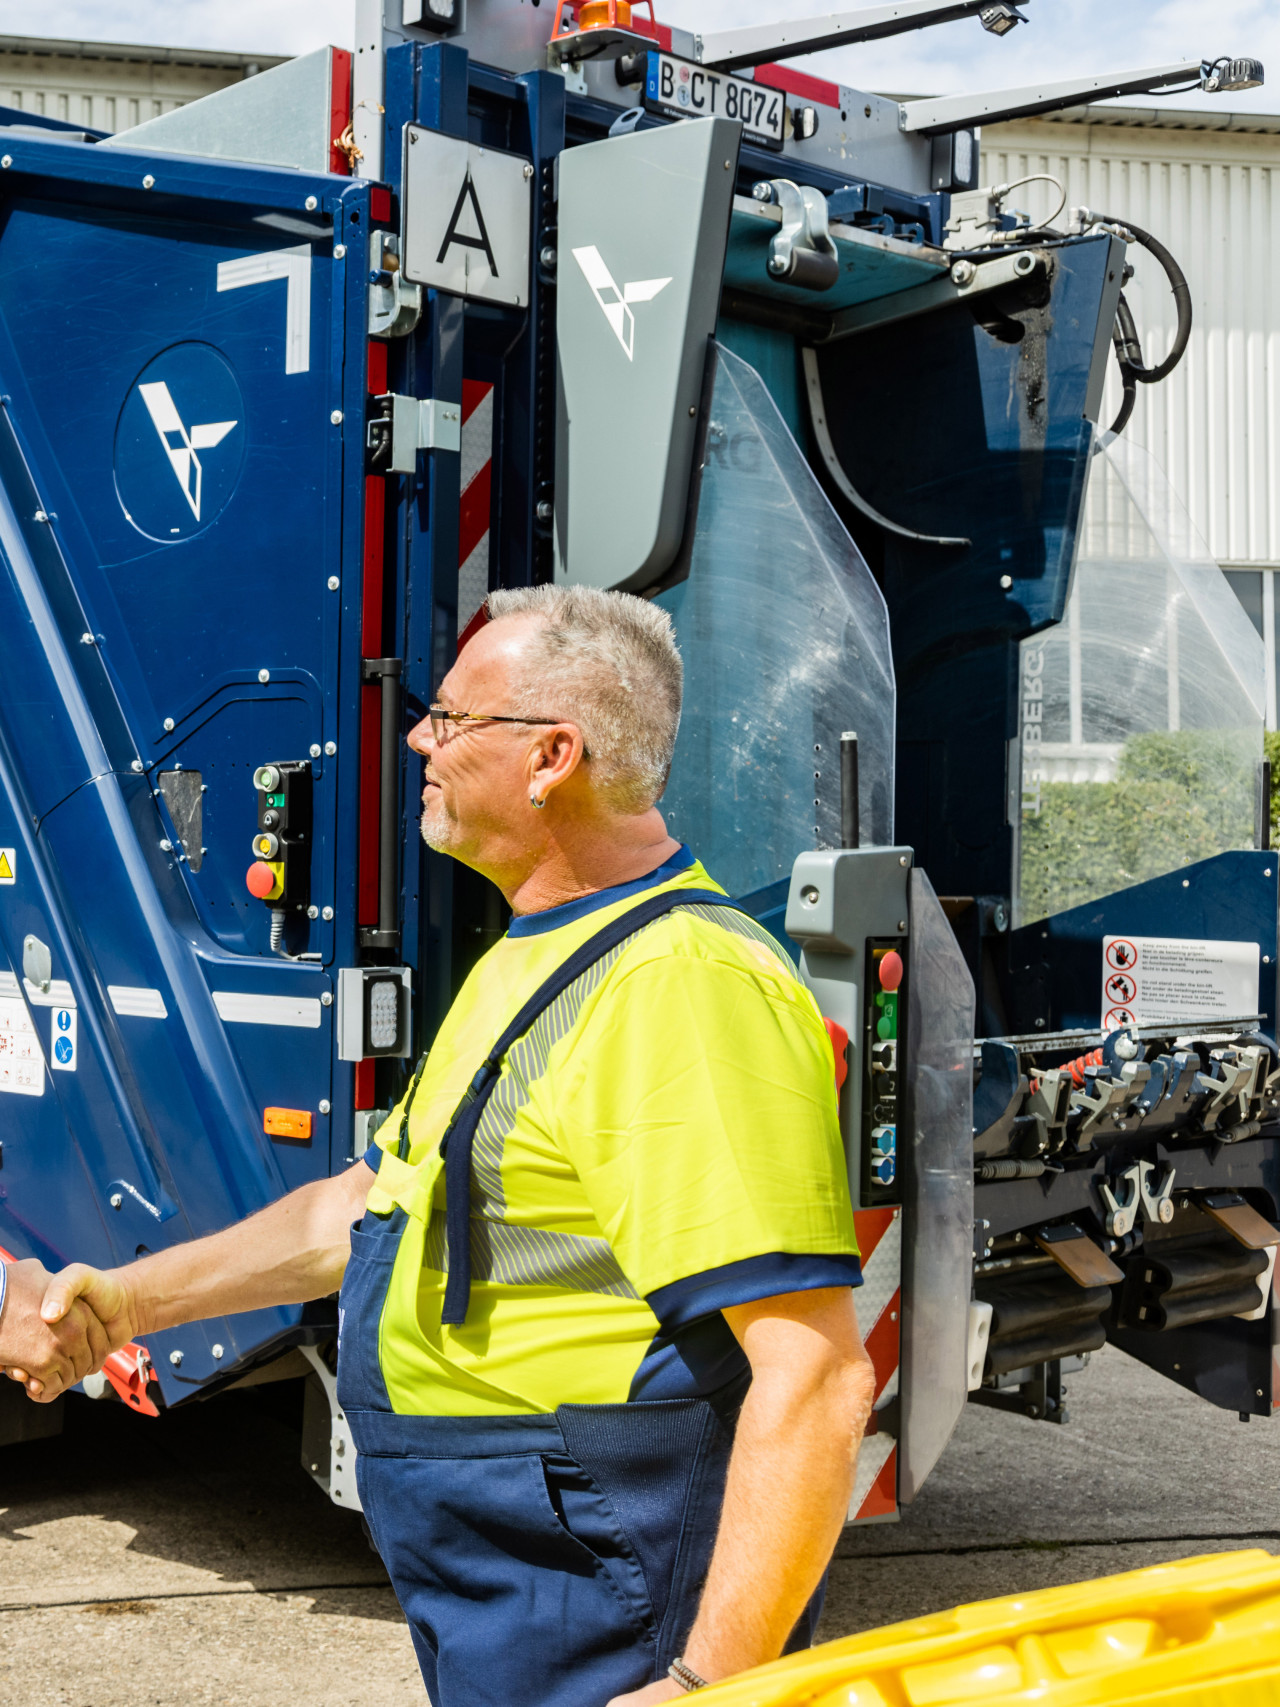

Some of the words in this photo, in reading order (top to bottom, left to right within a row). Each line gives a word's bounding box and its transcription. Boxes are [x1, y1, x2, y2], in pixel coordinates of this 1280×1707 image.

[660, 61, 674, 98] B
[691, 72, 720, 113] CT
[726, 83, 779, 132] 8074
[436, 166, 500, 278] A
